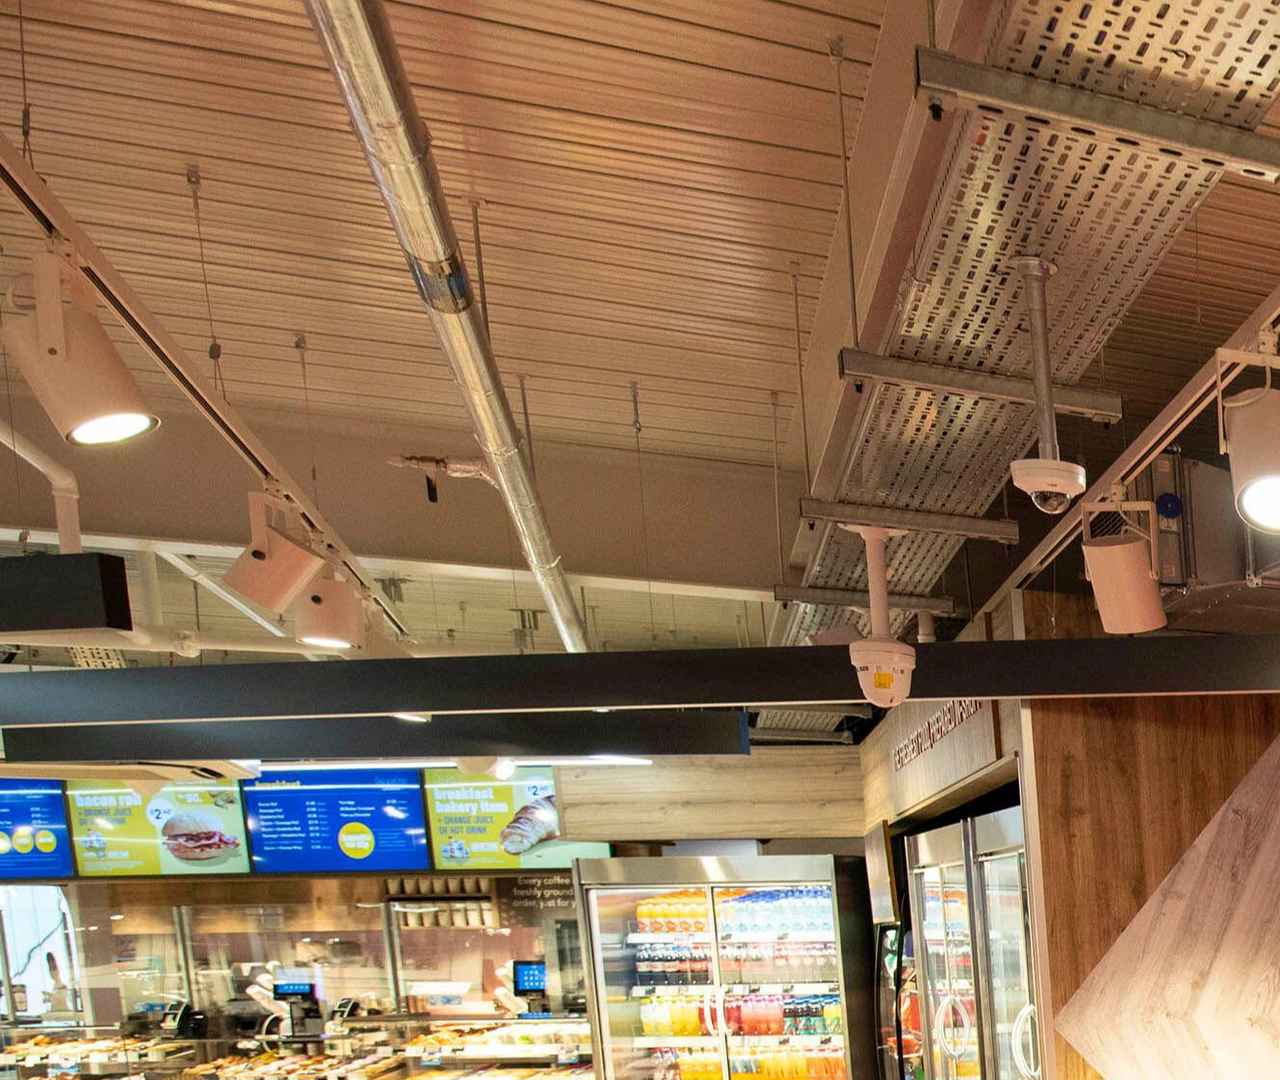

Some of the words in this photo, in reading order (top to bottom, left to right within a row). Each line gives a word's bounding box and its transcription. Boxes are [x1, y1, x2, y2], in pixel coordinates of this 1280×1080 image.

[74, 793, 117, 807] bacon
[119, 792, 142, 806] roll
[433, 787, 495, 800] breakfast
[435, 801, 478, 816] bakery
[480, 800, 509, 813] item
[444, 816, 472, 825] ORANGE
[474, 816, 494, 824] JUICE
[517, 876, 542, 887] Every
[543, 875, 571, 885] coffee
[543, 887, 574, 898] ground
